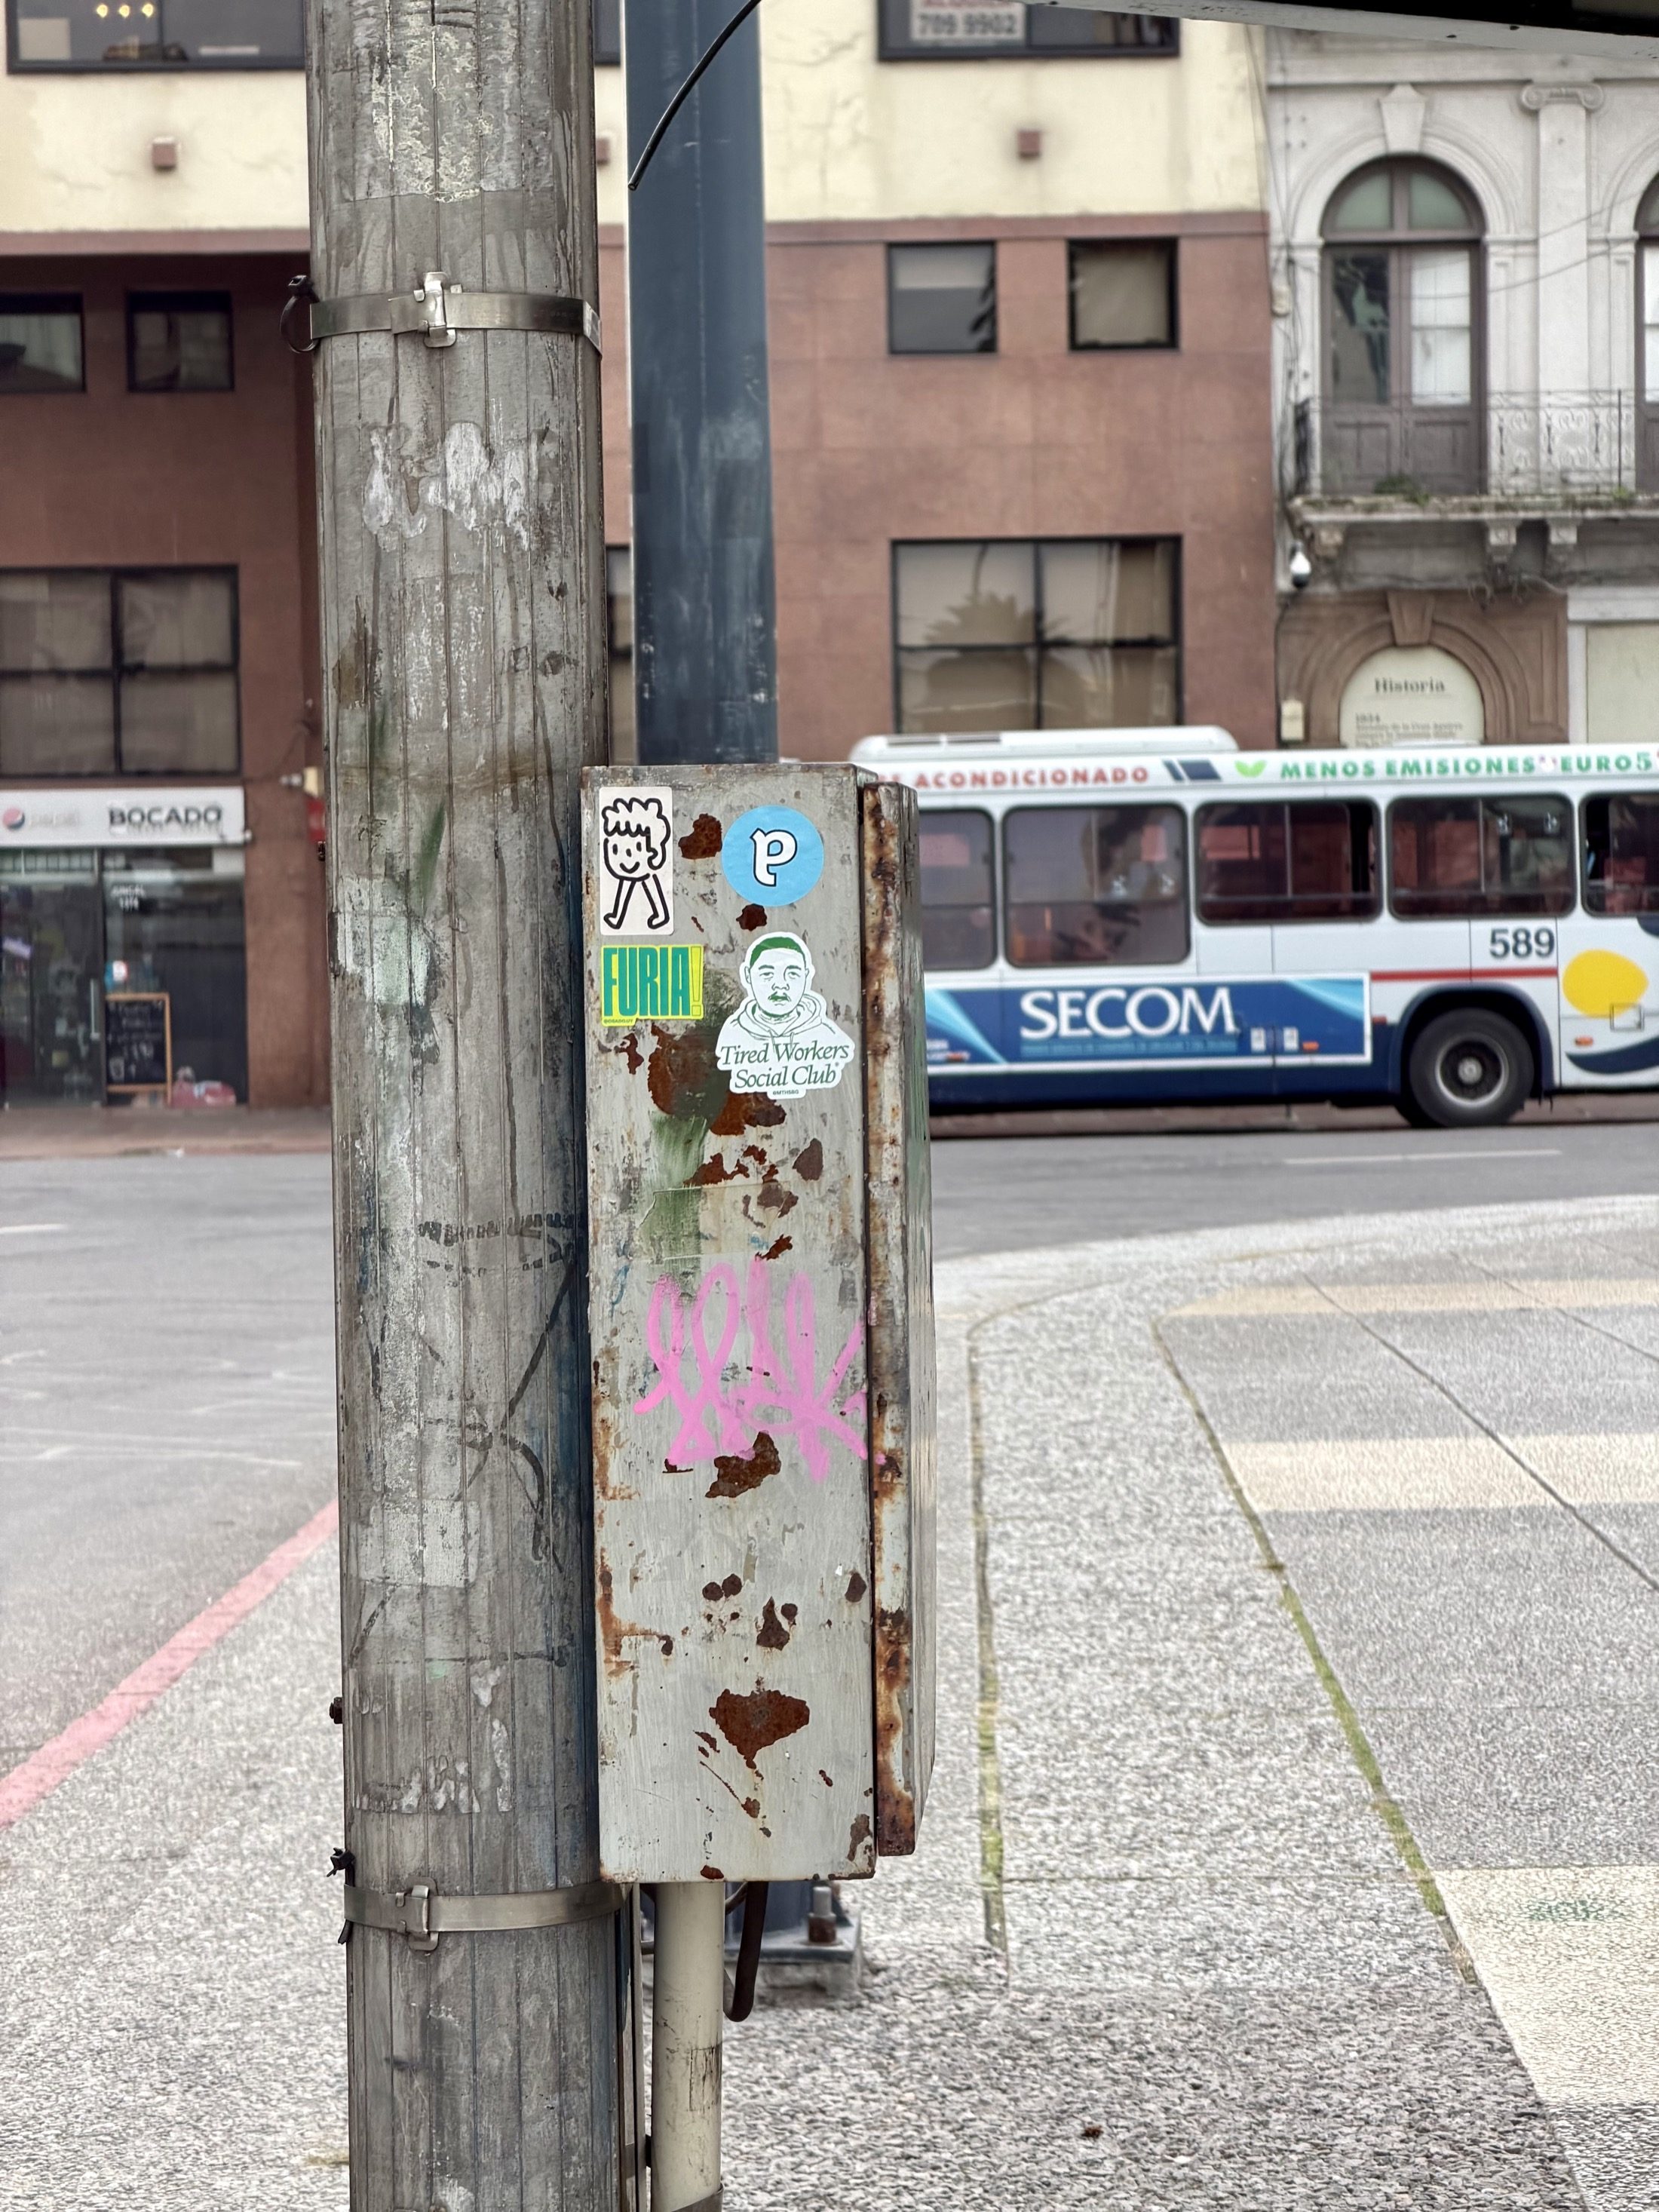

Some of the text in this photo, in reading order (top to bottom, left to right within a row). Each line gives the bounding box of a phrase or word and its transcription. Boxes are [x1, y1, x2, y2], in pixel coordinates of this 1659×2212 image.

[1375, 676, 1445, 693] Historia
[915, 765, 1148, 789] ACONDICIONADO
[1281, 751, 1652, 779] MENOS EMISIONES EURO5
[108, 806, 222, 826] BOCADO
[1490, 927, 1555, 959] 589
[603, 946, 701, 1017] FURIA!
[1020, 985, 1237, 1040] SECOM
[720, 1040, 850, 1065] Tired Workers
[734, 1066, 788, 1088] Social
